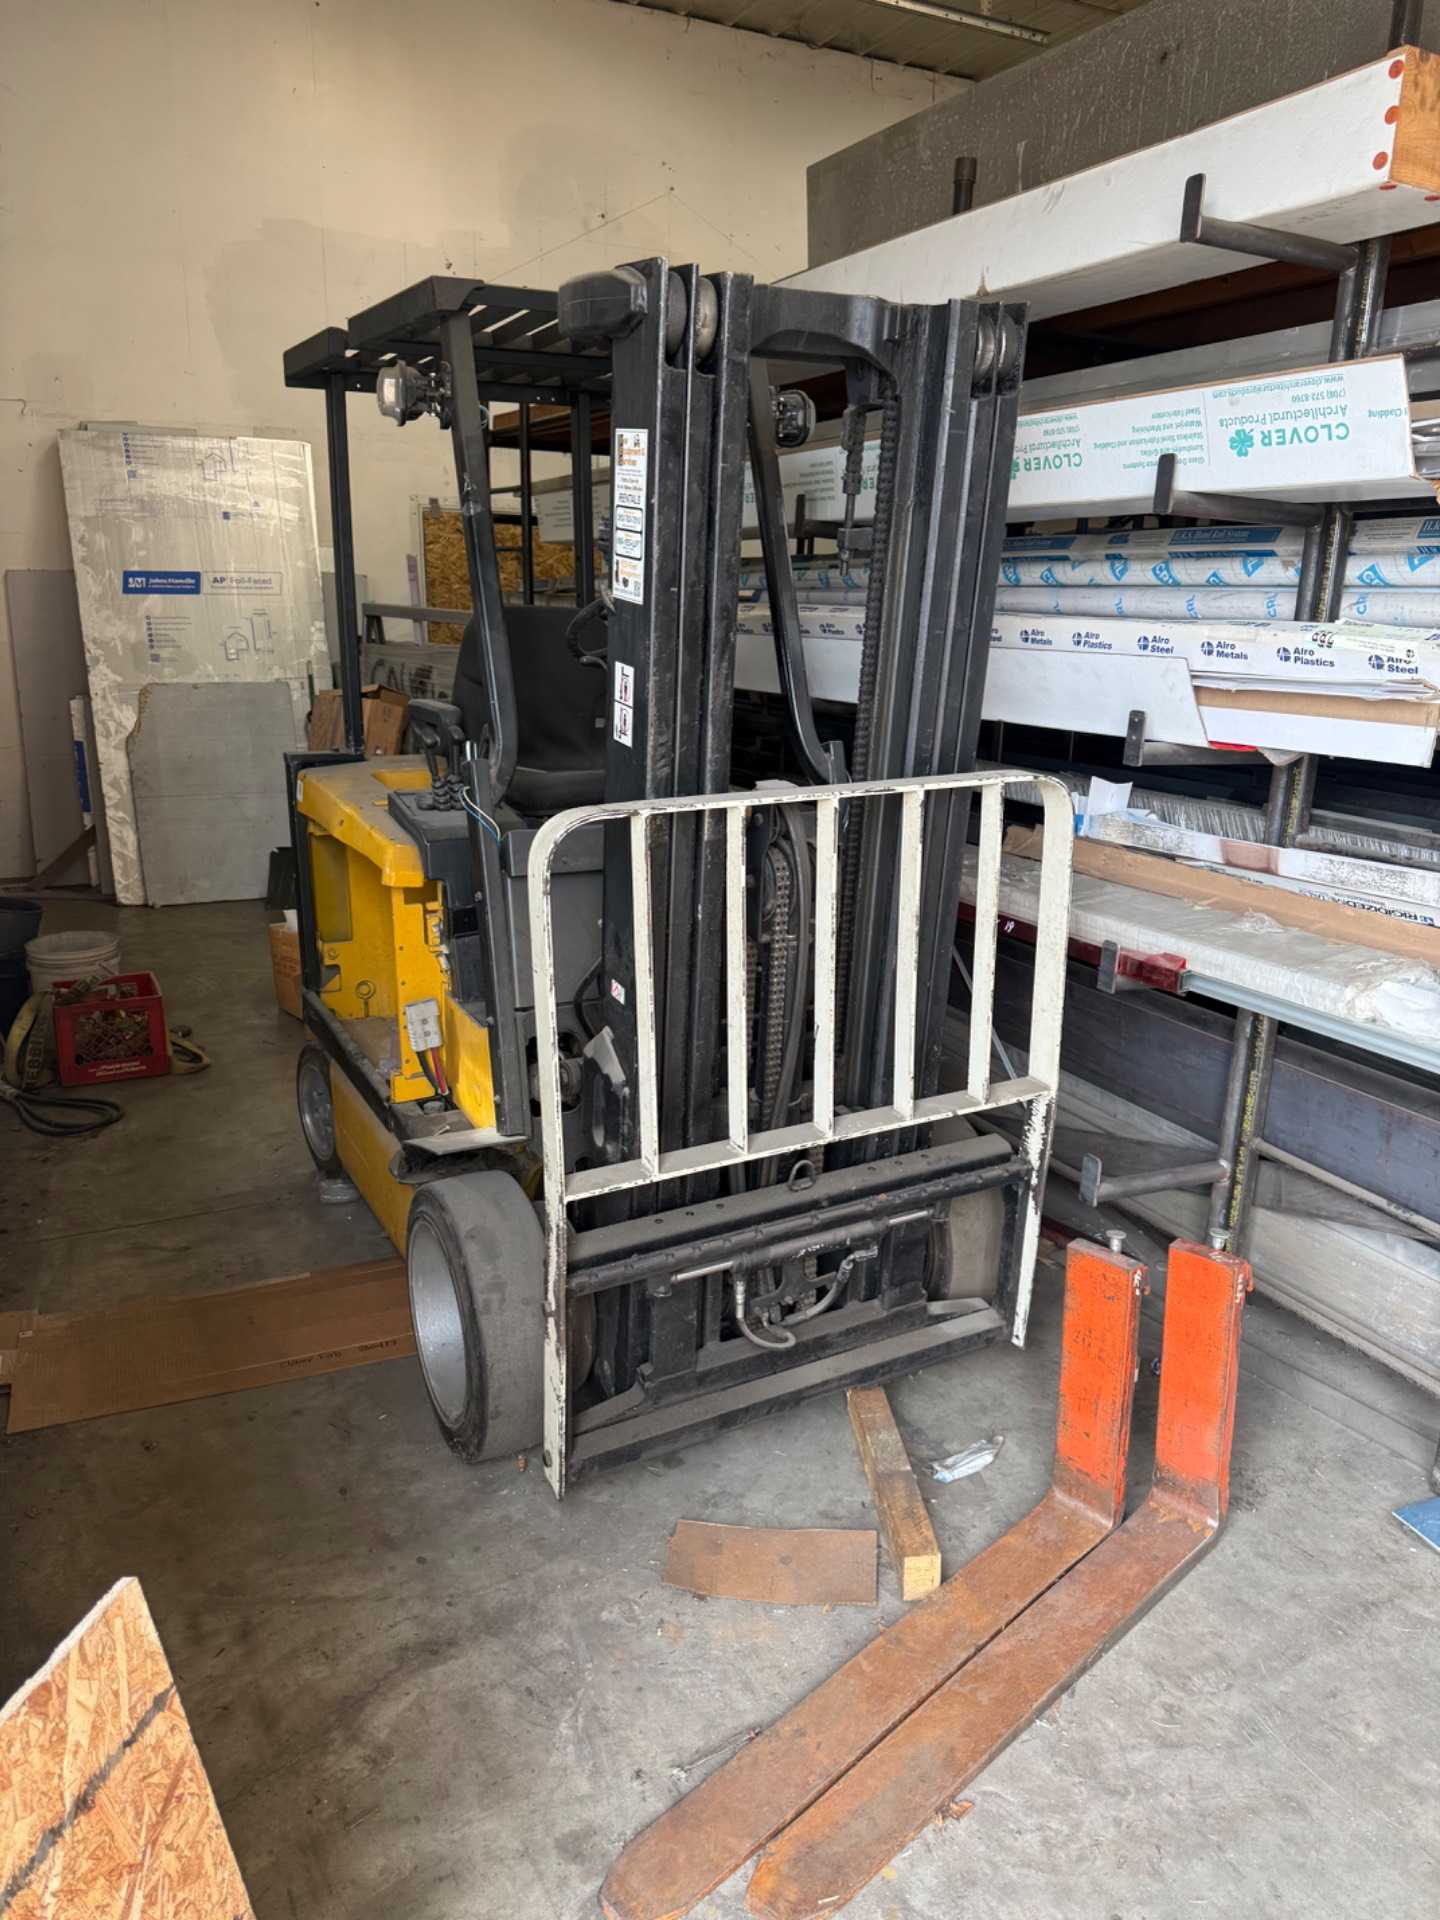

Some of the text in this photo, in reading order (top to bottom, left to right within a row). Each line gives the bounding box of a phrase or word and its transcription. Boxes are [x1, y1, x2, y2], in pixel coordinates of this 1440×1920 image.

[1219, 404, 1349, 428] Architectural Products
[1260, 422, 1350, 447] CLOVER
[1029, 438, 1081, 453] Architectural
[1023, 452, 1083, 472] CLOVER
[1030, 636, 1053, 646] Metals
[1082, 639, 1113, 650] Plastics
[1149, 643, 1174, 654] Steel
[1215, 649, 1249, 661] Metals
[1292, 656, 1336, 668] Plastics
[1387, 662, 1419, 675] Steel
